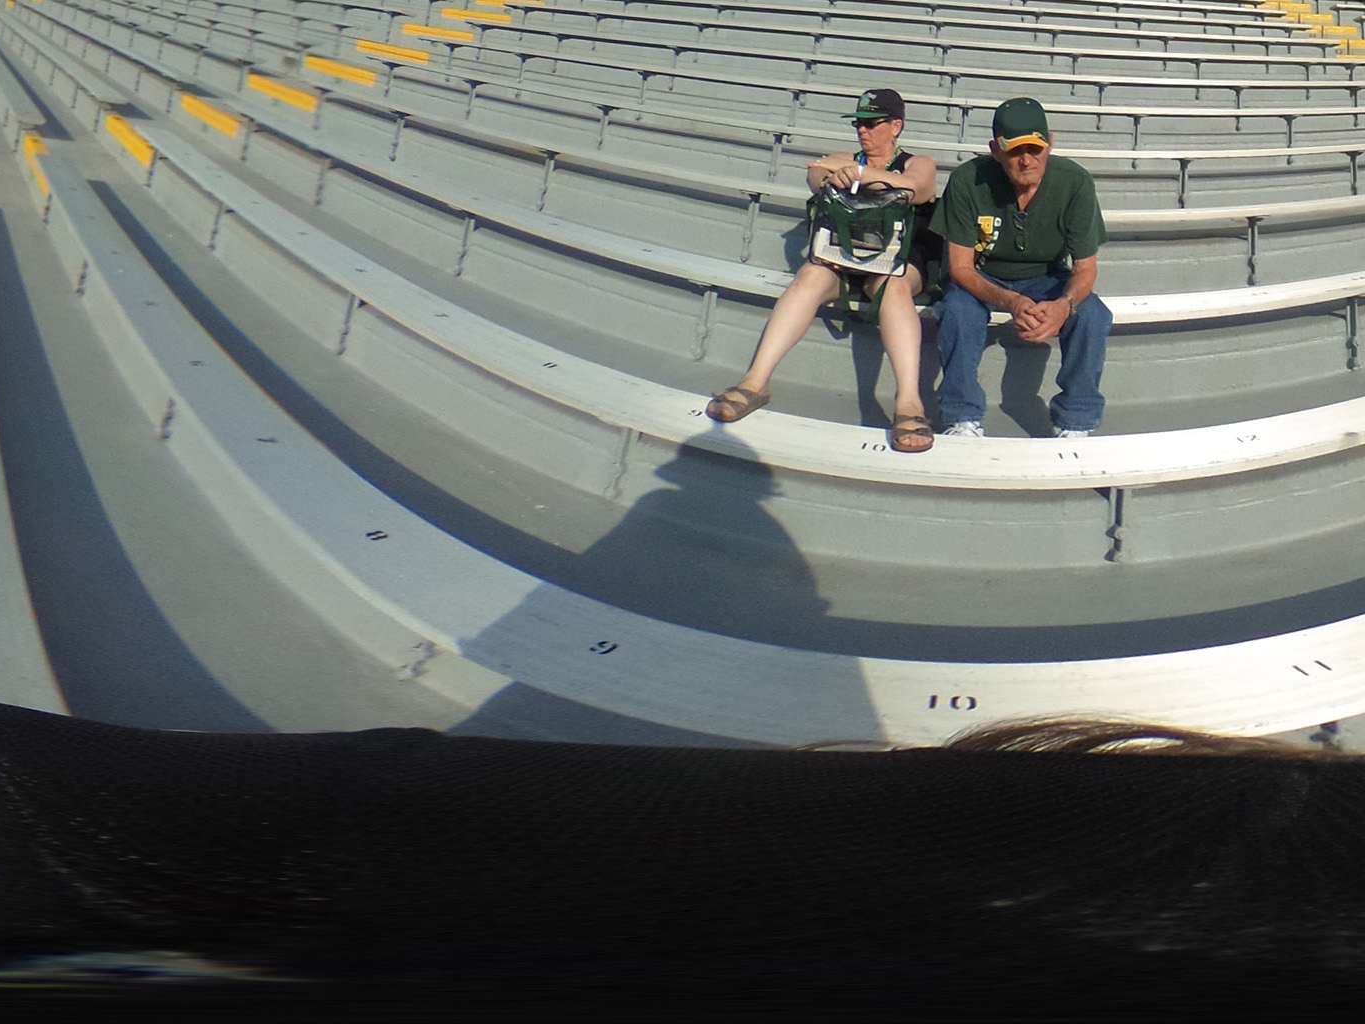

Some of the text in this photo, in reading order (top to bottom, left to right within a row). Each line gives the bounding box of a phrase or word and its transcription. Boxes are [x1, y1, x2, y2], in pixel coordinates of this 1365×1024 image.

[862, 443, 886, 451] 10
[365, 530, 389, 541] 8
[589, 641, 619, 655] 9
[1292, 660, 1332, 676] 11
[928, 694, 977, 711] 10
